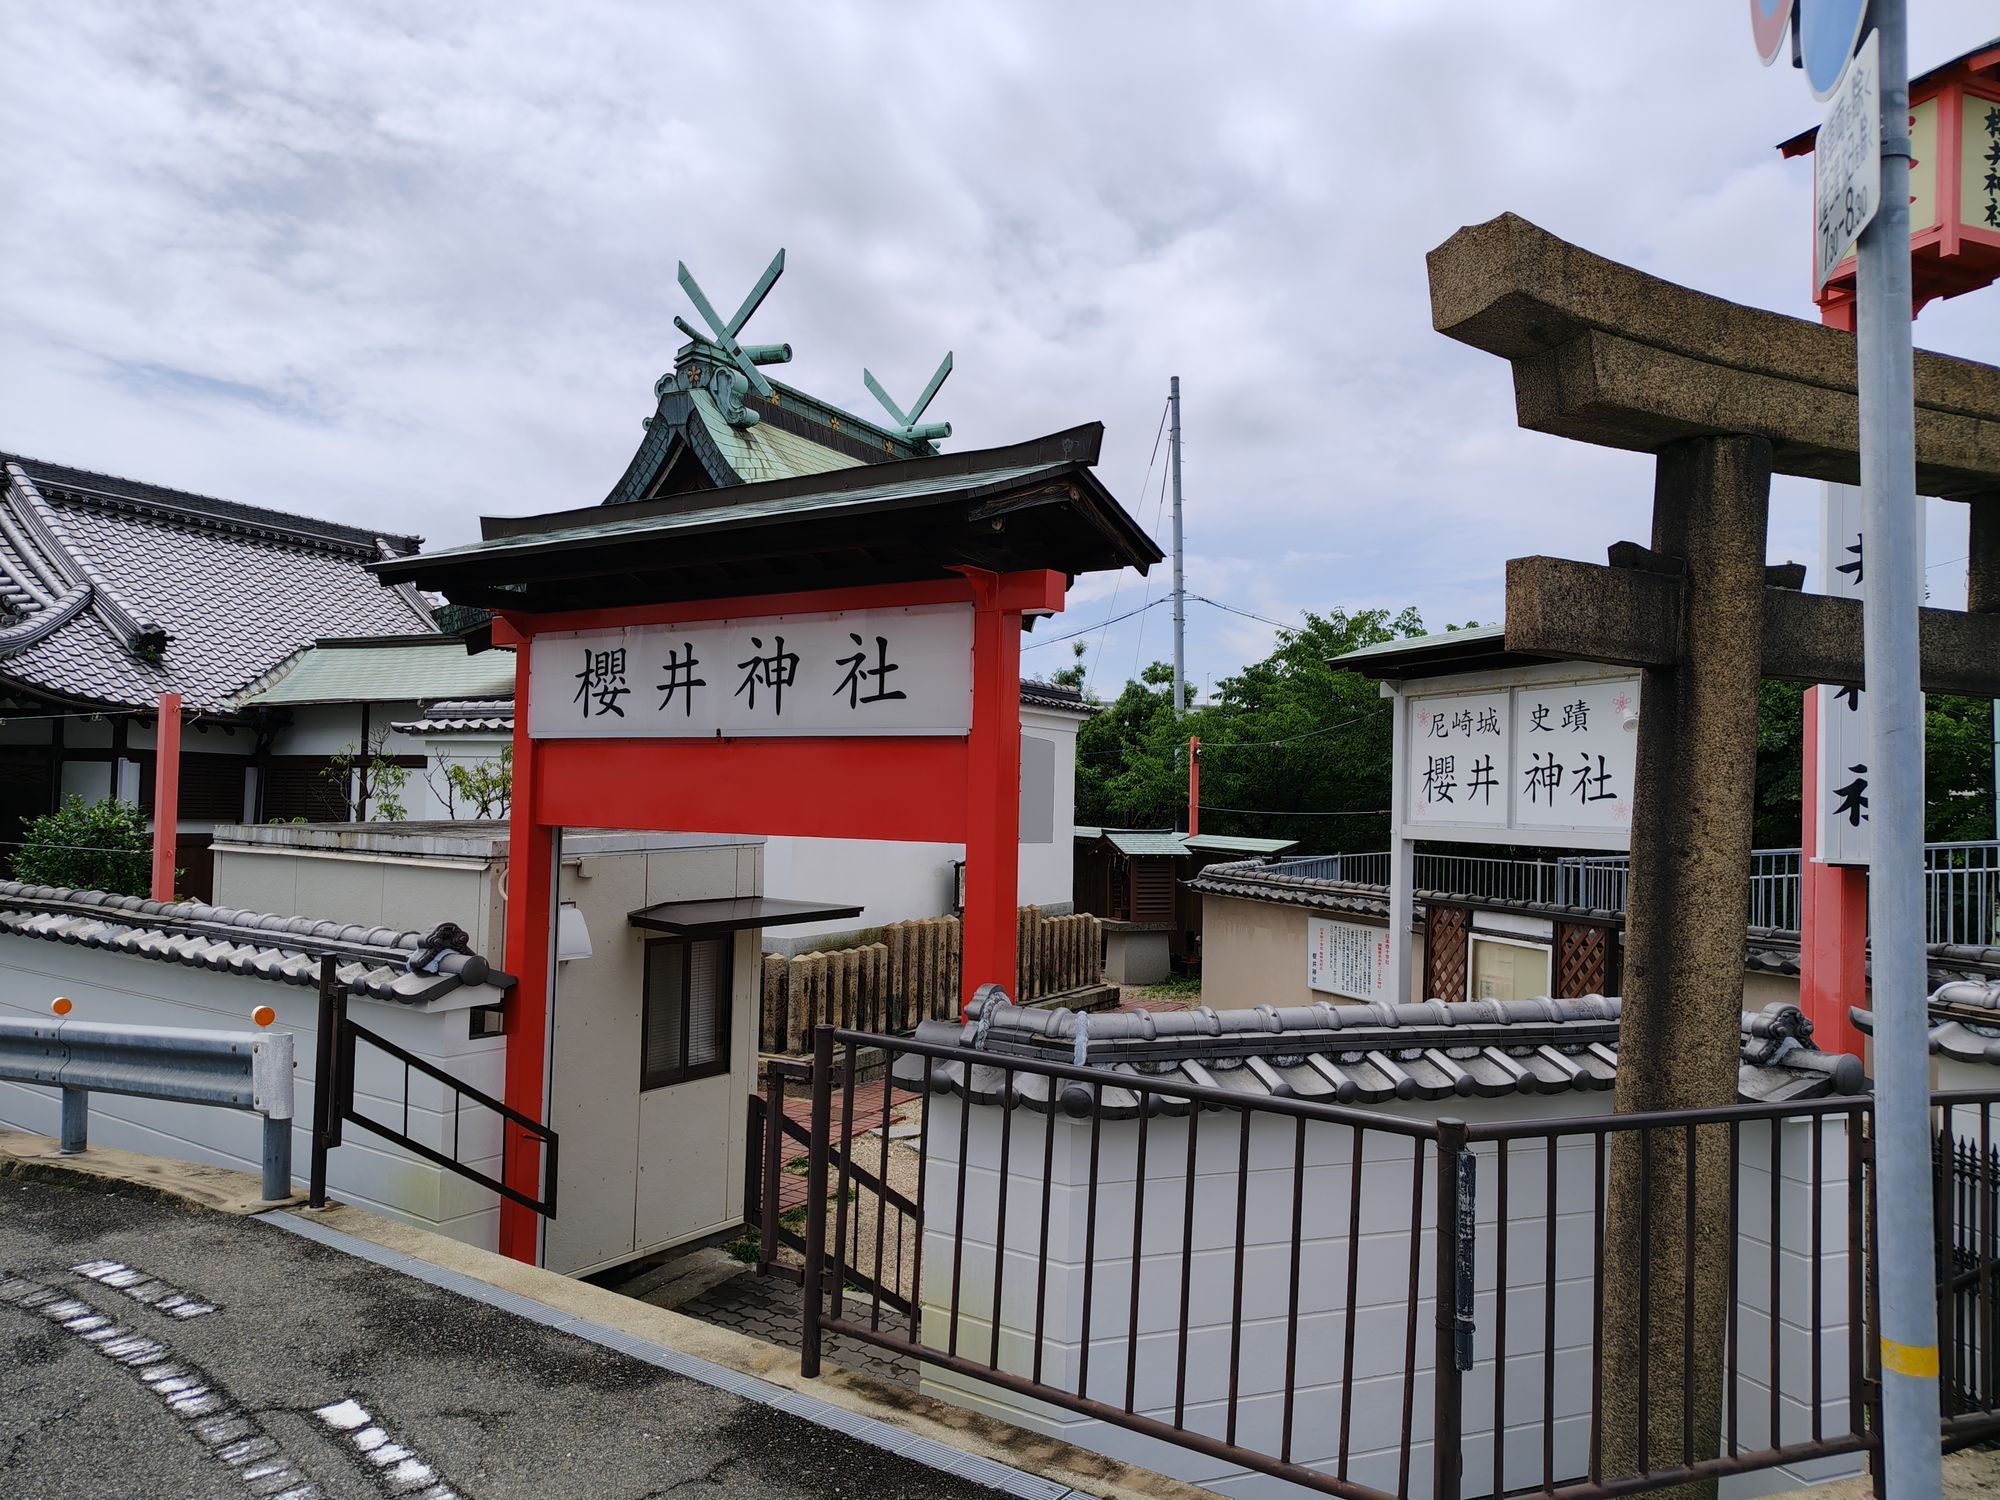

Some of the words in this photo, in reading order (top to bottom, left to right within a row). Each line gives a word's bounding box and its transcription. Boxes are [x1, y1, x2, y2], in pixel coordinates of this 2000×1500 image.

[573, 632, 907, 719] 櫻井神社
[1427, 706, 1500, 738] 尼崎城
[1529, 699, 1590, 732] 史蹟
[1422, 752, 1618, 808] 櫻井神社
